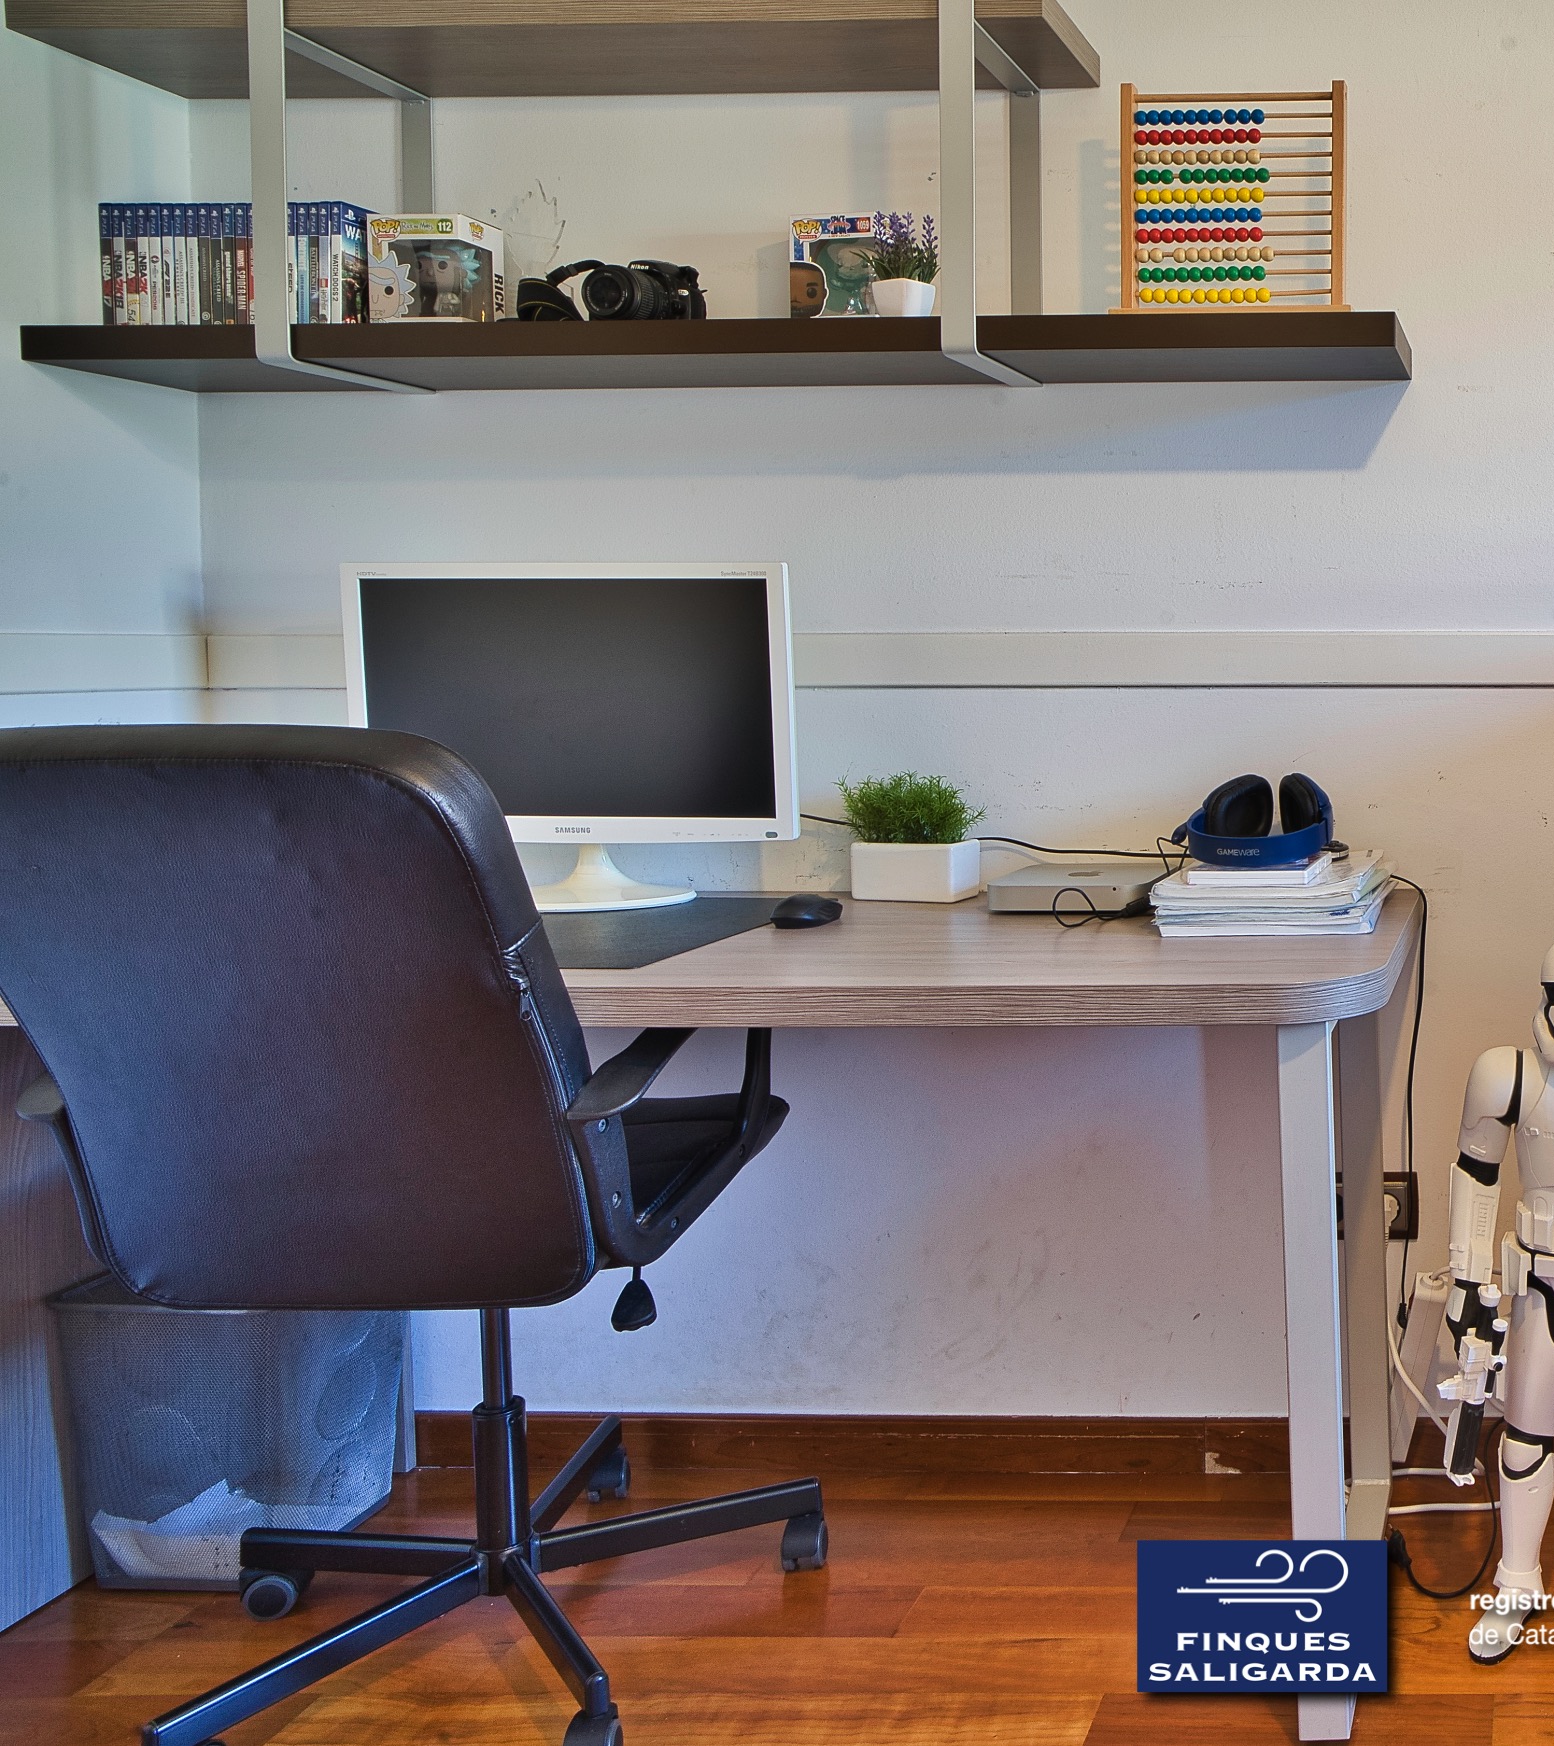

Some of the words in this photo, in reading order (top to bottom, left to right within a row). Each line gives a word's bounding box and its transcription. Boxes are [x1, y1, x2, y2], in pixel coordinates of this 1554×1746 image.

[370, 220, 400, 234] POP!
[438, 221, 452, 232] 112
[792, 220, 822, 234] POP!
[494, 273, 504, 314] RICK
